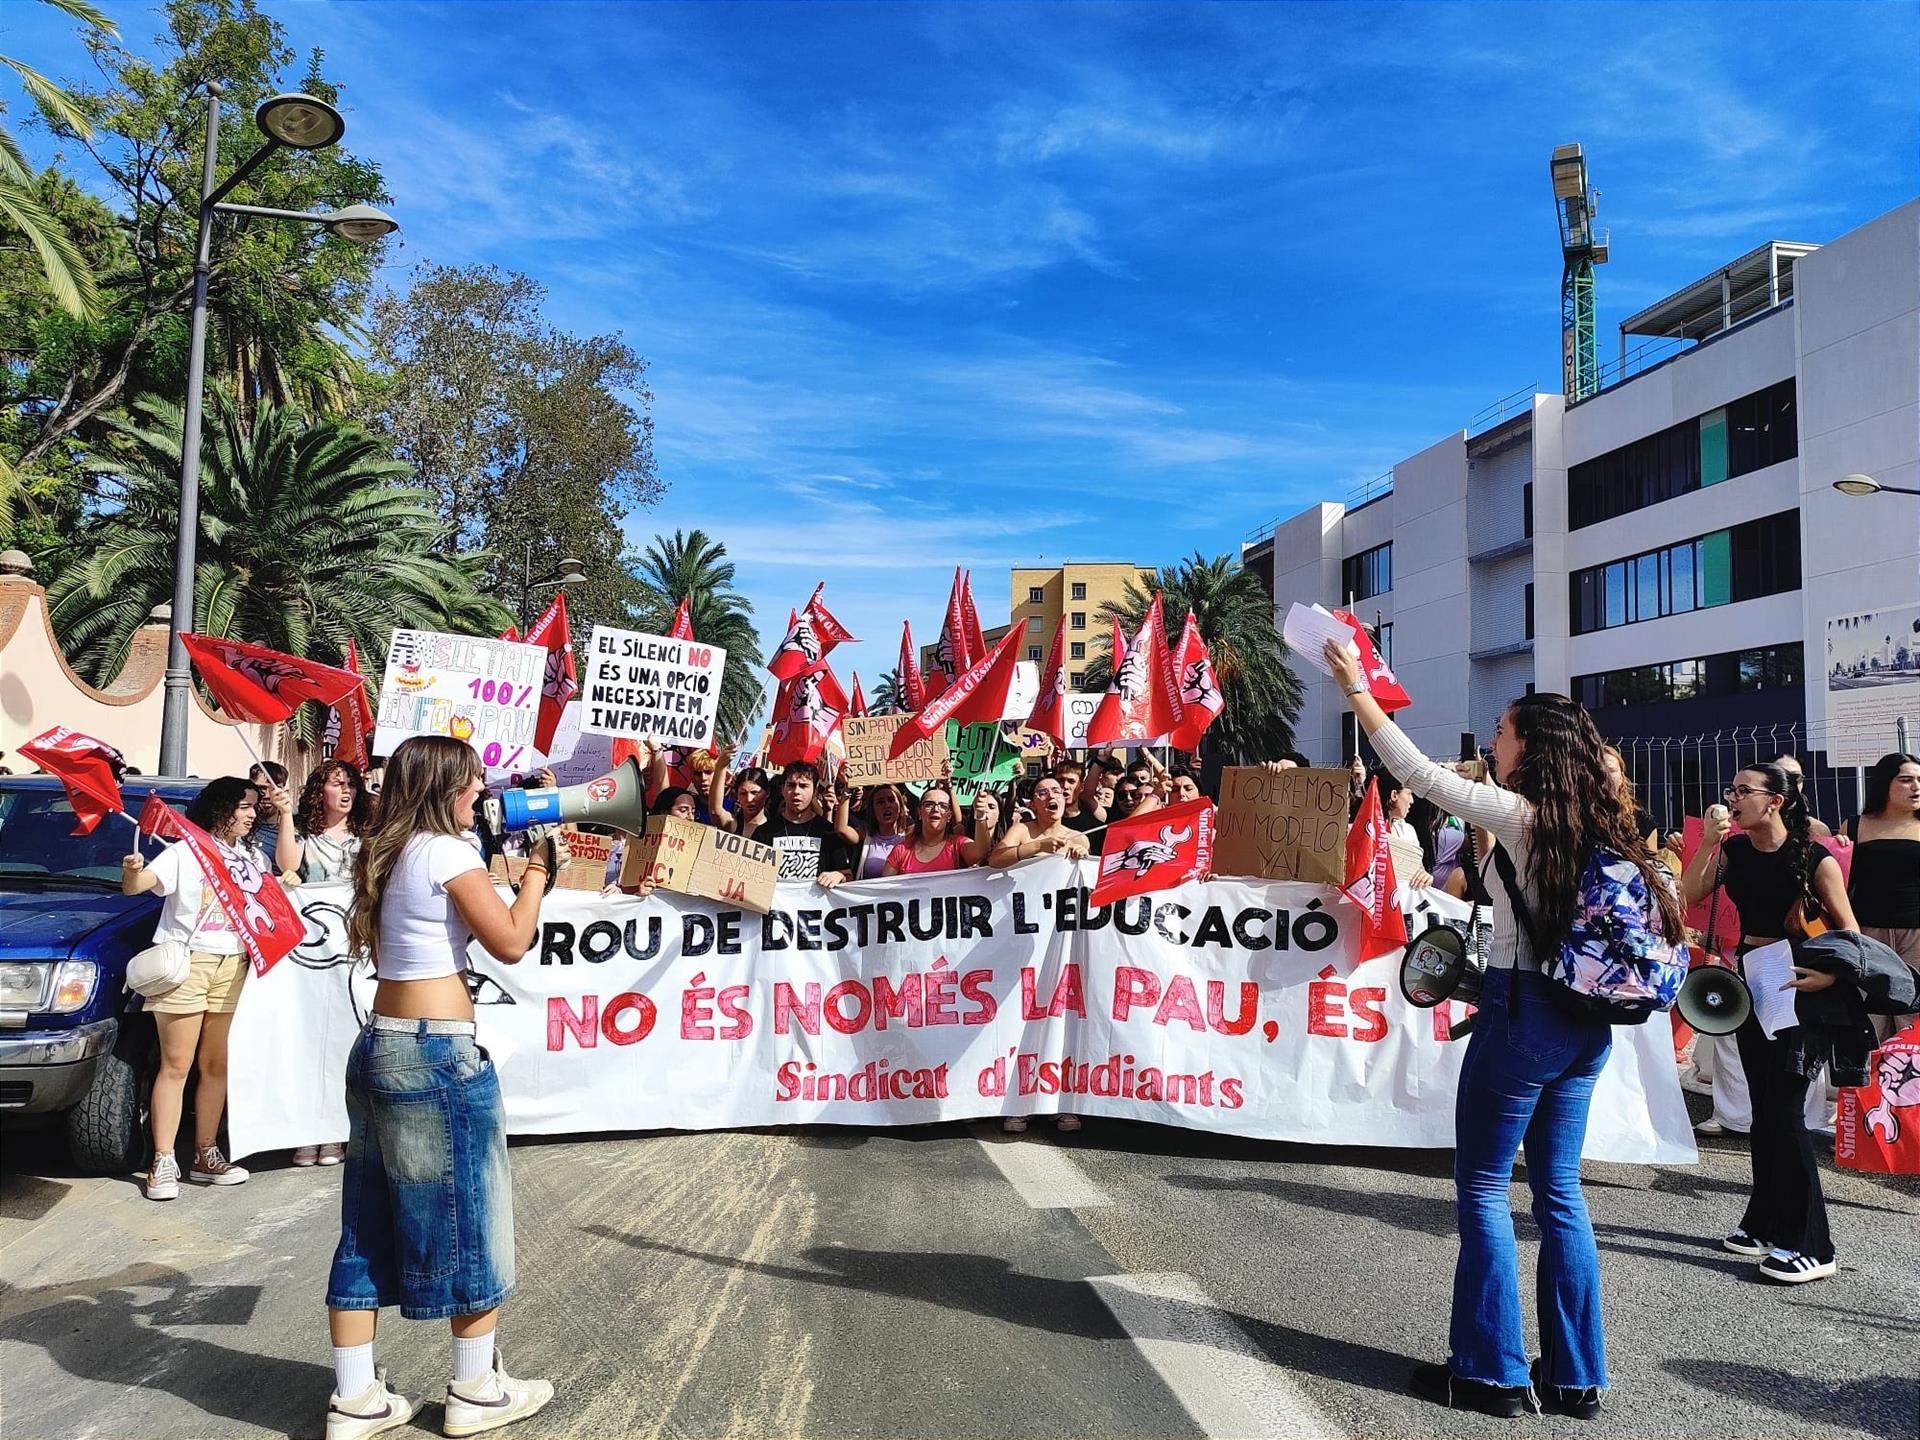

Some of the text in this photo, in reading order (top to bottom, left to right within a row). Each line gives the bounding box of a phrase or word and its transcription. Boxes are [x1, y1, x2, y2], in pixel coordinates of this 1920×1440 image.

[391, 632, 544, 684] ANSIETAT
[598, 636, 617, 655] EL
[688, 647, 712, 668] NO
[599, 660, 621, 681] ÉS
[628, 666, 661, 687] UNA
[467, 677, 533, 709] 100%
[921, 683, 966, 730] Sindicat
[477, 704, 537, 746] PAU
[848, 721, 866, 736] SIN
[869, 717, 894, 735] PAU
[483, 742, 524, 769] 0%
[849, 745, 863, 759] ES
[949, 749, 997, 774] ES UN
[866, 762, 881, 777] UN
[885, 758, 935, 779] ERROR
[643, 832, 685, 853] FUTUR
[779, 839, 815, 848] NIKE
[1198, 807, 1212, 848] Sindicat
[1220, 811, 1340, 854] UN MODELO
[663, 848, 680, 864] UN
[715, 831, 777, 867] VOLEM
[1257, 846, 1301, 879] YA!
[718, 878, 745, 902] JA
[681, 910, 742, 957] DE
[761, 894, 994, 952] DESTRUIR
[1012, 885, 1338, 952] L'EDUCACIÓ
[547, 991, 658, 1052] NO
[680, 971, 754, 1041] ÉS
[773, 955, 998, 1035] NOMÉS
[1020, 963, 1088, 1021] LA
[1112, 965, 1280, 1044] PAU,
[1307, 963, 1390, 1042] ÉS
[776, 1046, 1245, 1110] Sindicat d'Estudiants
[1839, 1092, 1856, 1160] Sindicat
